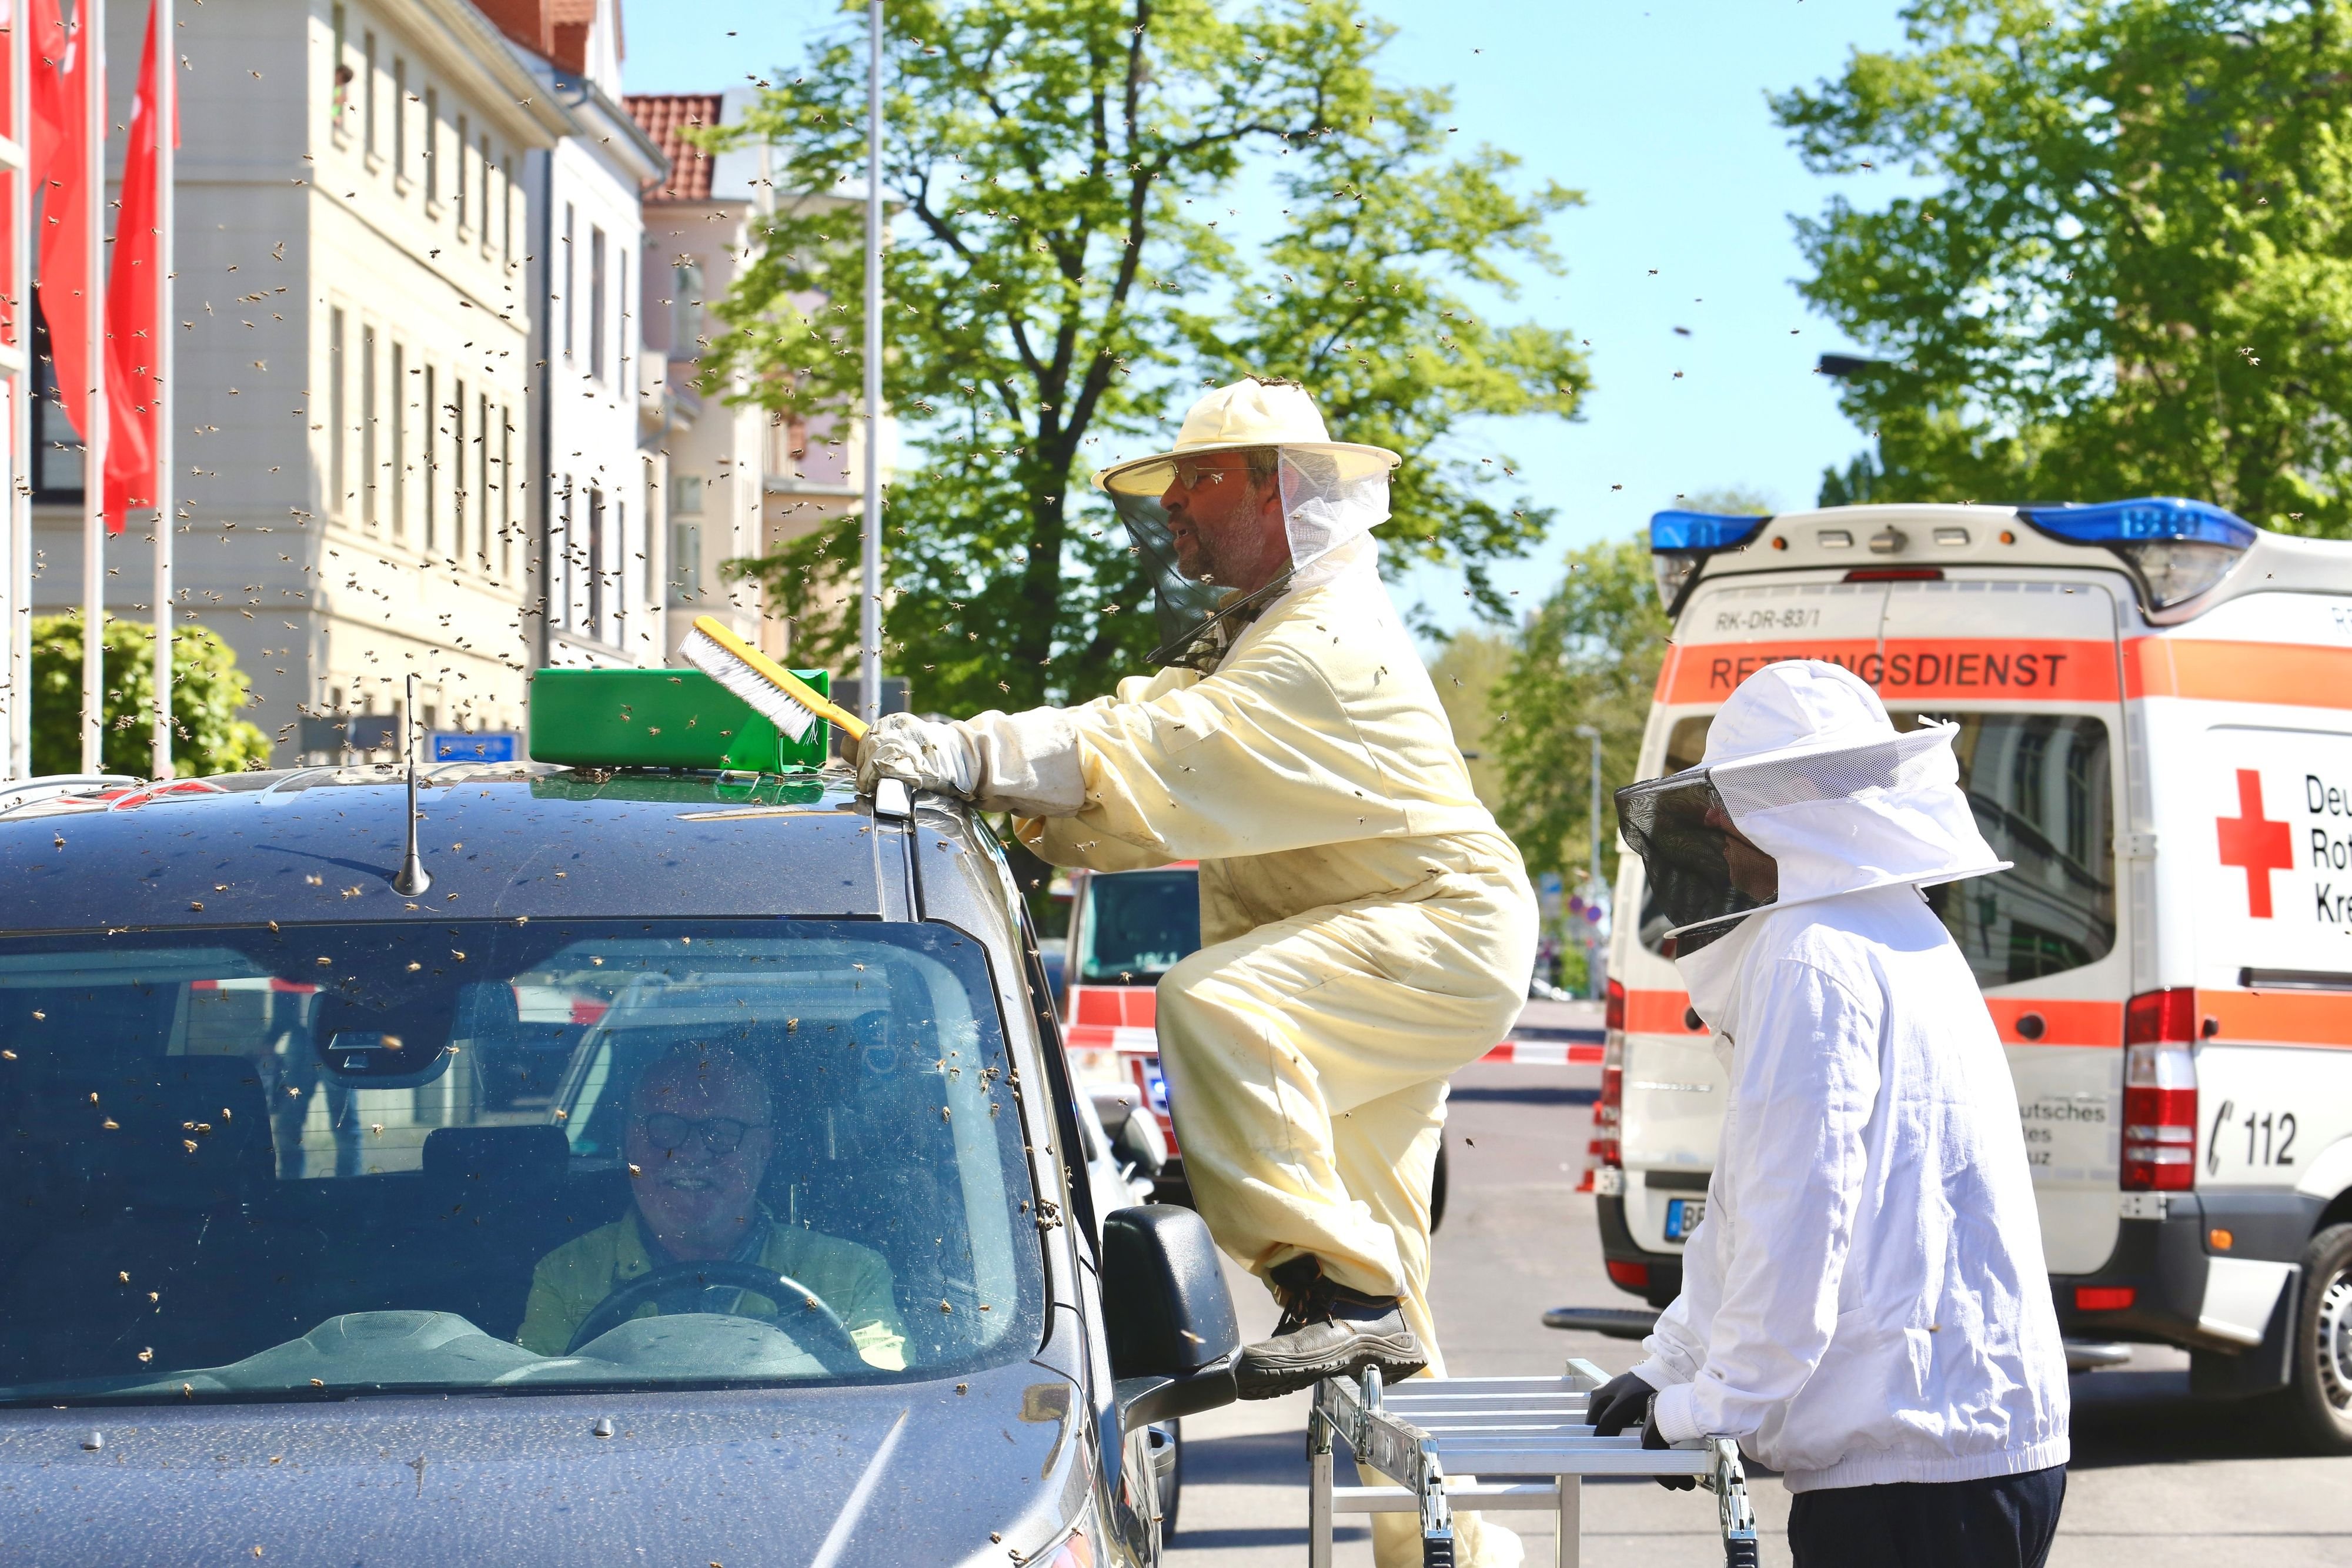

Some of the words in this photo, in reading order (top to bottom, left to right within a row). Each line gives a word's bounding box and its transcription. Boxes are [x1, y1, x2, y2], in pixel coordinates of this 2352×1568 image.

[1715, 609, 1820, 631] RK-DR-83/1
[1710, 653, 2067, 688] REGSDIENST
[2244, 1111, 2296, 1165] 112
